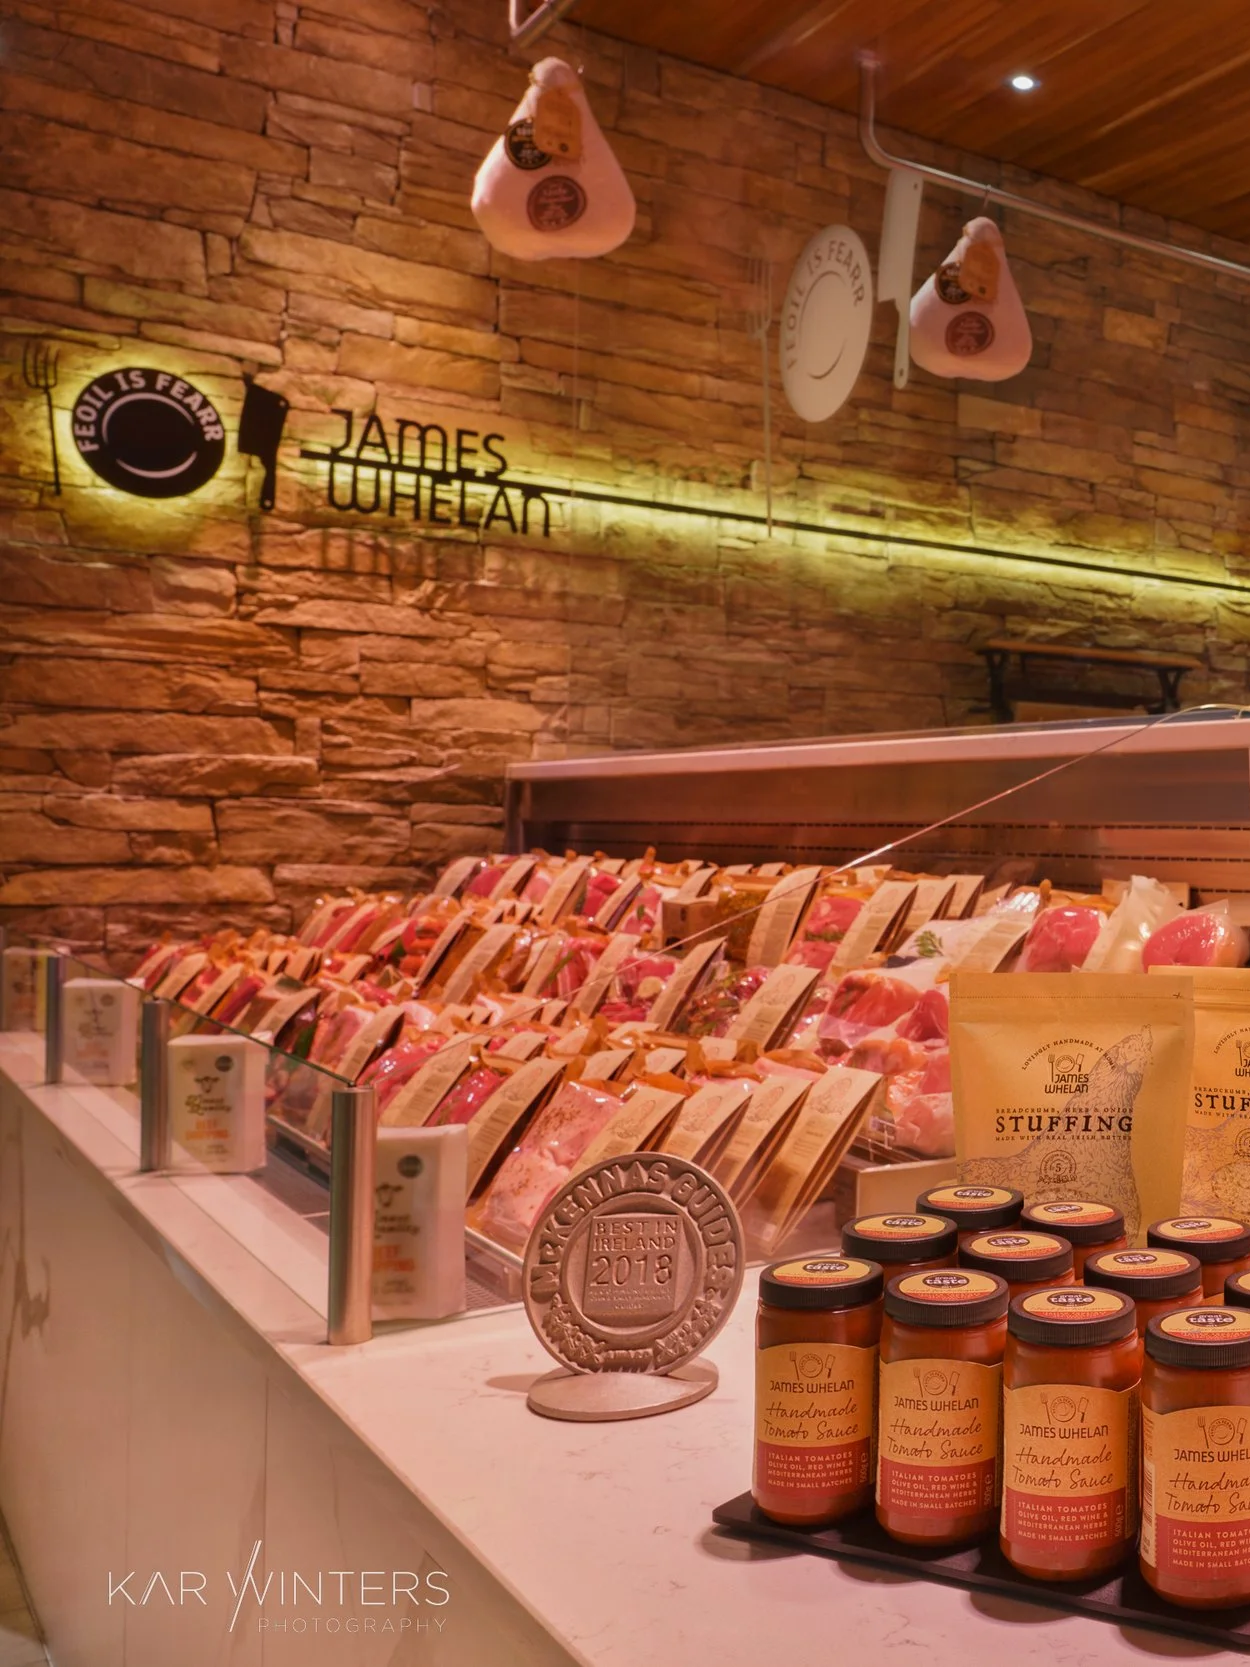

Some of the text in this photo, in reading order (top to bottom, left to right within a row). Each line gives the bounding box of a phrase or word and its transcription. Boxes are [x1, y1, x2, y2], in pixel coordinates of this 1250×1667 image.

[806, 247, 821, 275] IS
[827, 239, 864, 307] FEARR
[75, 371, 224, 452] FEOIL IS FEARR
[330, 408, 507, 475] JAMES
[328, 461, 550, 537] WHELAN
[1055, 1074, 1089, 1083] JAMES
[1045, 1084, 1088, 1093] WHELAN
[995, 1116, 1133, 1133] STUFFING
[1055, 1163, 1061, 1172] 5
[596, 1220, 676, 1235] BEST IN
[593, 1237, 676, 1251] IRELAND
[590, 1255, 673, 1287] 2018
[766, 1379, 854, 1393] JAMES WHELAN
[766, 1398, 857, 1418] Handmade
[894, 1396, 979, 1412] JAMES WHELAN
[763, 1419, 859, 1441] Tomato Sauce
[890, 1416, 982, 1437] Handmade
[1020, 1424, 1108, 1438] JAMES WHELAN
[887, 1436, 983, 1459] Tomato Sauce
[1016, 1444, 1112, 1465] Handmade
[1174, 1448, 1214, 1462] JAMES
[768, 1451, 853, 1462] ITALIAN TOMATOES
[892, 1471, 976, 1482] ITALIAN TOMATOES
[1012, 1465, 1113, 1489] Tomato Sauce
[1018, 1502, 1107, 1512] ITALIAN TOMATOES
[1165, 1492, 1221, 1514] Tomato
[1173, 1529, 1211, 1538] ITALIAN
